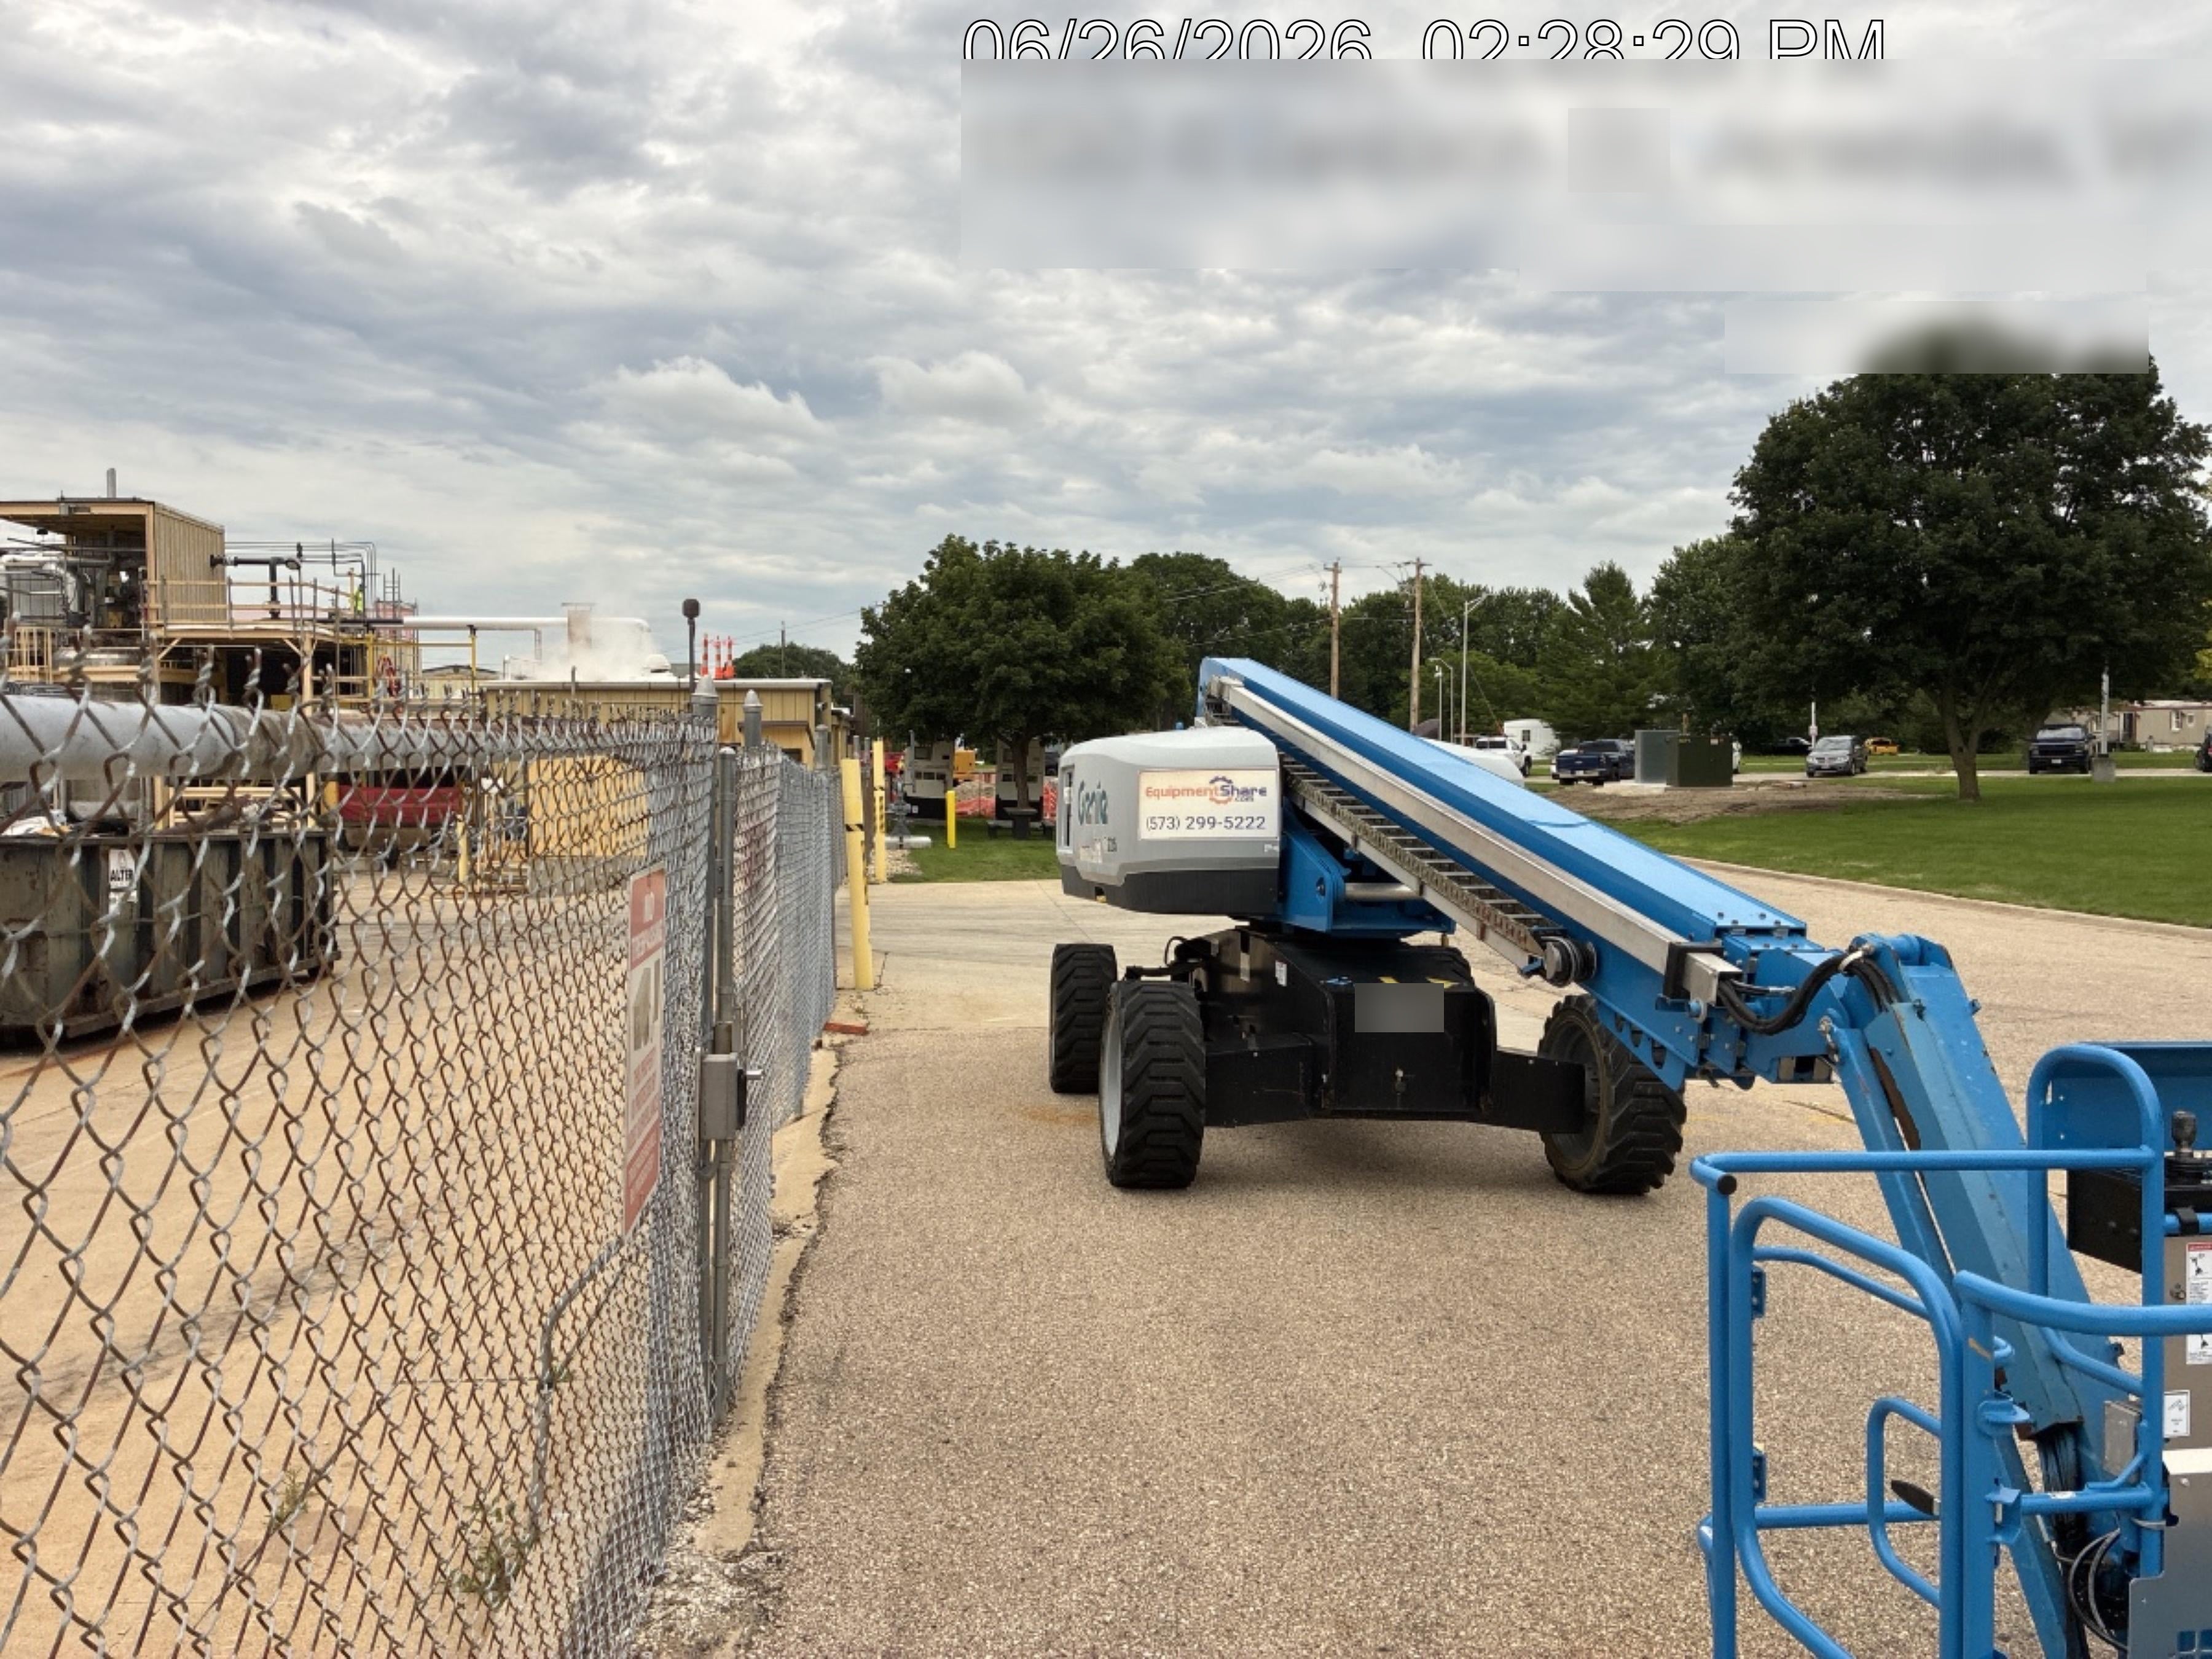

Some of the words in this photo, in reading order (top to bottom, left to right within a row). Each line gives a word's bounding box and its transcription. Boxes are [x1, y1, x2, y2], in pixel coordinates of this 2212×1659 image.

[1146, 785, 1267, 800] EquipmentShare
[1146, 816, 1180, 831] (573)
[1185, 816, 1266, 830] 299-5222
